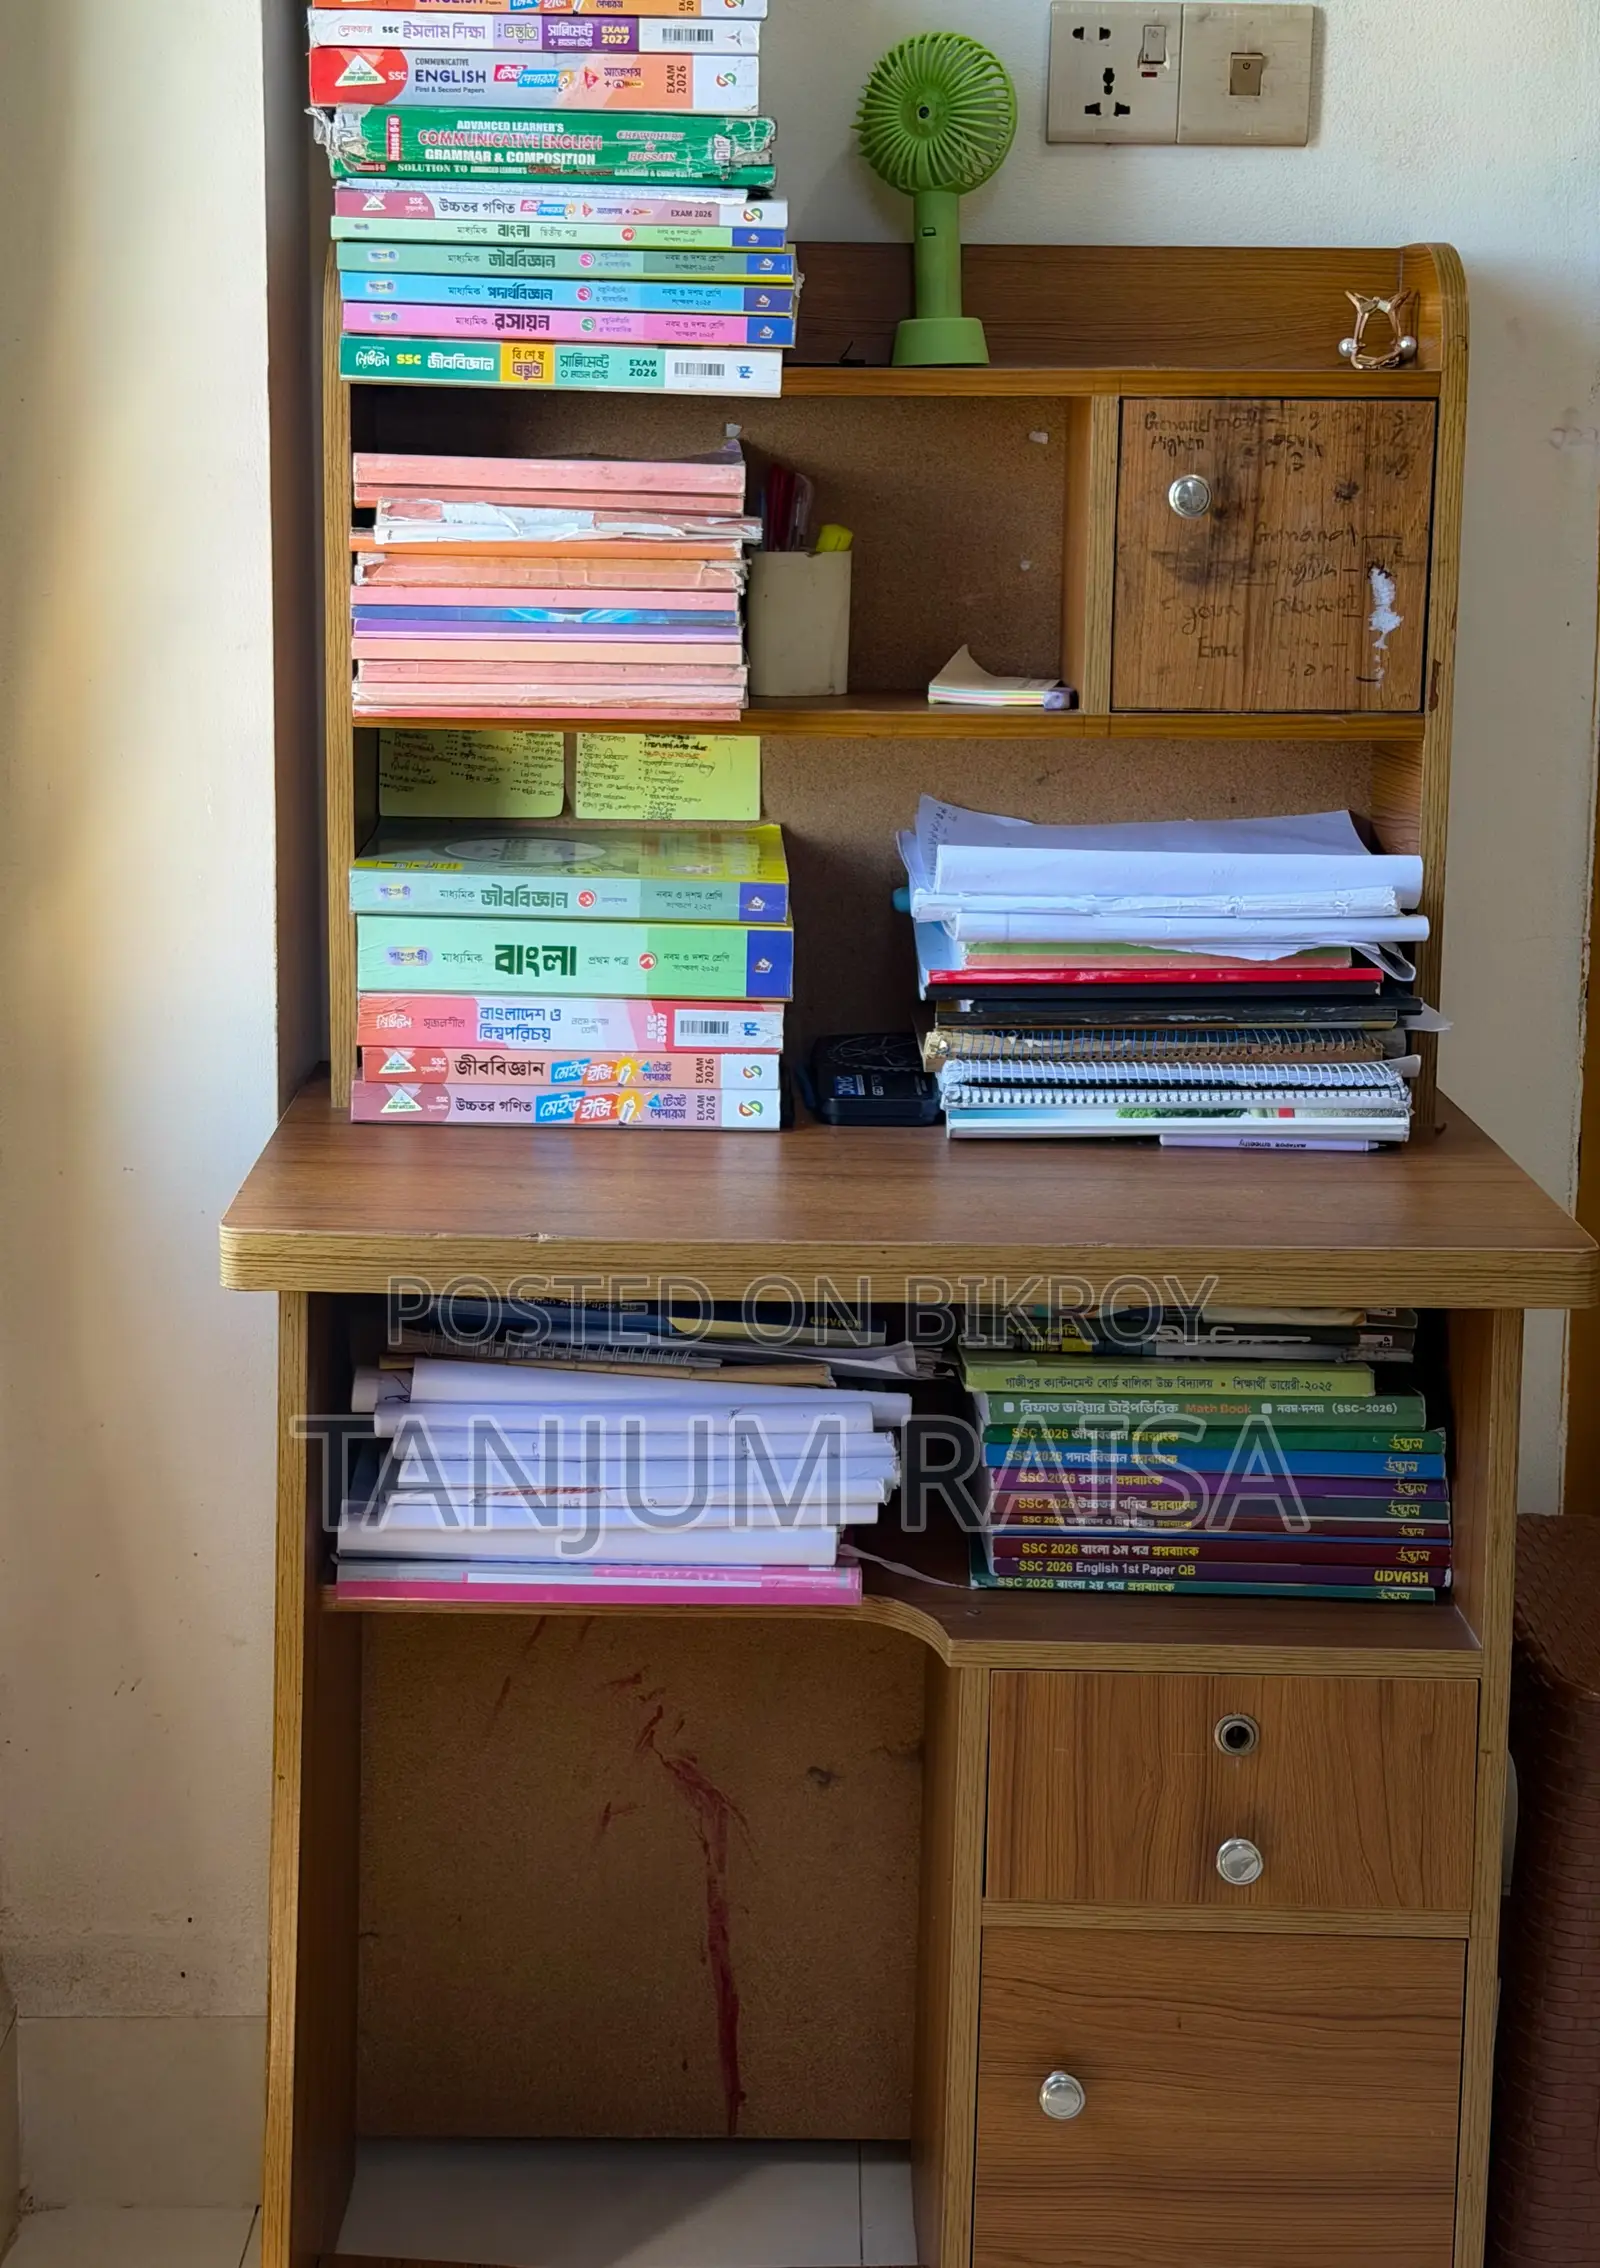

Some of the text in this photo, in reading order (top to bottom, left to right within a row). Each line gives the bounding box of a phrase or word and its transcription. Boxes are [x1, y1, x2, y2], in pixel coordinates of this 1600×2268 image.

[382, 26, 399, 34] SSC
[402, 21, 450, 38] ইসলাম
[452, 22, 486, 39] শিক্ষা
[601, 26, 629, 34] EXAM
[601, 35, 630, 44] 2027
[416, 58, 469, 66] COMMUNICATIVE
[388, 71, 407, 80] SSC
[415, 70, 486, 83] ENGLISH
[666, 65, 675, 94] EXAM
[676, 66, 686, 94] 2026
[457, 120, 564, 133] ADVANCED LEARNER'S
[418, 130, 602, 150] COMMUNICATIVE ENGLISH
[425, 149, 596, 166] GRAMMAR & COMPOSITION
[398, 164, 468, 172] SOLUTION TO
[439, 198, 516, 214] উচ্চতর গণিত
[671, 210, 712, 218] EXAM 2026
[498, 224, 530, 238] বাংলা
[489, 250, 556, 268] জীববিজ্ঞান
[488, 283, 553, 301] পদার্থবিজ্ঞান
[494, 312, 550, 332] রসায়ন
[396, 354, 422, 365] SSC
[428, 352, 494, 370] জীববিজ্ঞান
[629, 368, 658, 377] 2026
[439, 884, 568, 908] মাধ্যমিক জীববিজ্ঞান
[442, 950, 483, 964] মাধ্যমিক
[495, 944, 577, 978] বাংলা
[480, 1008, 562, 1022] বাংলাদেশ ও
[479, 1024, 551, 1042] বিশ্বপরিচয়
[647, 1014, 657, 1039] SSC
[657, 1012, 668, 1044] 2027
[454, 1054, 546, 1076] জীববিজ্ঞান
[554, 1060, 589, 1080] মেইড
[696, 1058, 704, 1084] EXAM
[706, 1058, 714, 1084] 2026
[456, 1098, 532, 1113] উচ্চতর গণিত
[540, 1096, 580, 1116] মেইড
[662, 1094, 686, 1106] টেস্ট
[706, 1095, 716, 1120] 2026
[580, 1100, 612, 1118] ইজি
[651, 1108, 686, 1120] পেপারস
[696, 1095, 705, 1121] EXAM
[1005, 1375, 1040, 1390] গাজীপুর
[1044, 1376, 1093, 1388] ক্যান্টনমেন্ট
[1098, 1375, 1119, 1388] বোর্ড
[1122, 1376, 1152, 1388] বালিকা
[1156, 1376, 1172, 1388] উচ্চ
[1177, 1376, 1212, 1390] বিদ্যালয়
[1232, 1376, 1266, 1390] শিক্ষার্থী
[1020, 1400, 1060, 1414] রিফাত
[1062, 1402, 1104, 1414] ভাইয়ার
[1108, 1400, 1178, 1414] টাইপভিত্তিক
[1185, 1404, 1218, 1414] Math
[1332, 1402, 1398, 1415] (SSC-2026)
[1012, 1428, 1036, 1438] SSC
[1041, 1428, 1069, 1438] 2026
[1006, 1450, 1032, 1461] SSC
[1035, 1451, 1062, 1462] 2026
[1019, 1472, 1044, 1483] SSC
[1048, 1473, 1076, 1484] 2026
[1078, 1474, 1113, 1486] রসায়ন
[1018, 1498, 1044, 1510] SSC
[1047, 1498, 1075, 1510] 2026
[1119, 1496, 1148, 1510] গণিত
[1022, 1516, 1040, 1524] SSC
[1042, 1516, 1064, 1524] 2026
[1022, 1543, 1048, 1554] SSC
[1051, 1544, 1078, 1554] 2026
[1081, 1544, 1110, 1554] বাংলা
[1112, 1545, 1128, 1555] ১ম
[1132, 1546, 1150, 1556] পত্র
[1019, 1560, 1196, 1576] SSC 2026 English 1st Paper QB
[997, 1577, 1023, 1588] SSC
[1026, 1578, 1054, 1588] 2026
[1057, 1580, 1086, 1590] বাংলা
[1089, 1580, 1104, 1591] ২য়
[1107, 1581, 1124, 1591] পত্র
[1374, 1570, 1429, 1584] UDVASH
